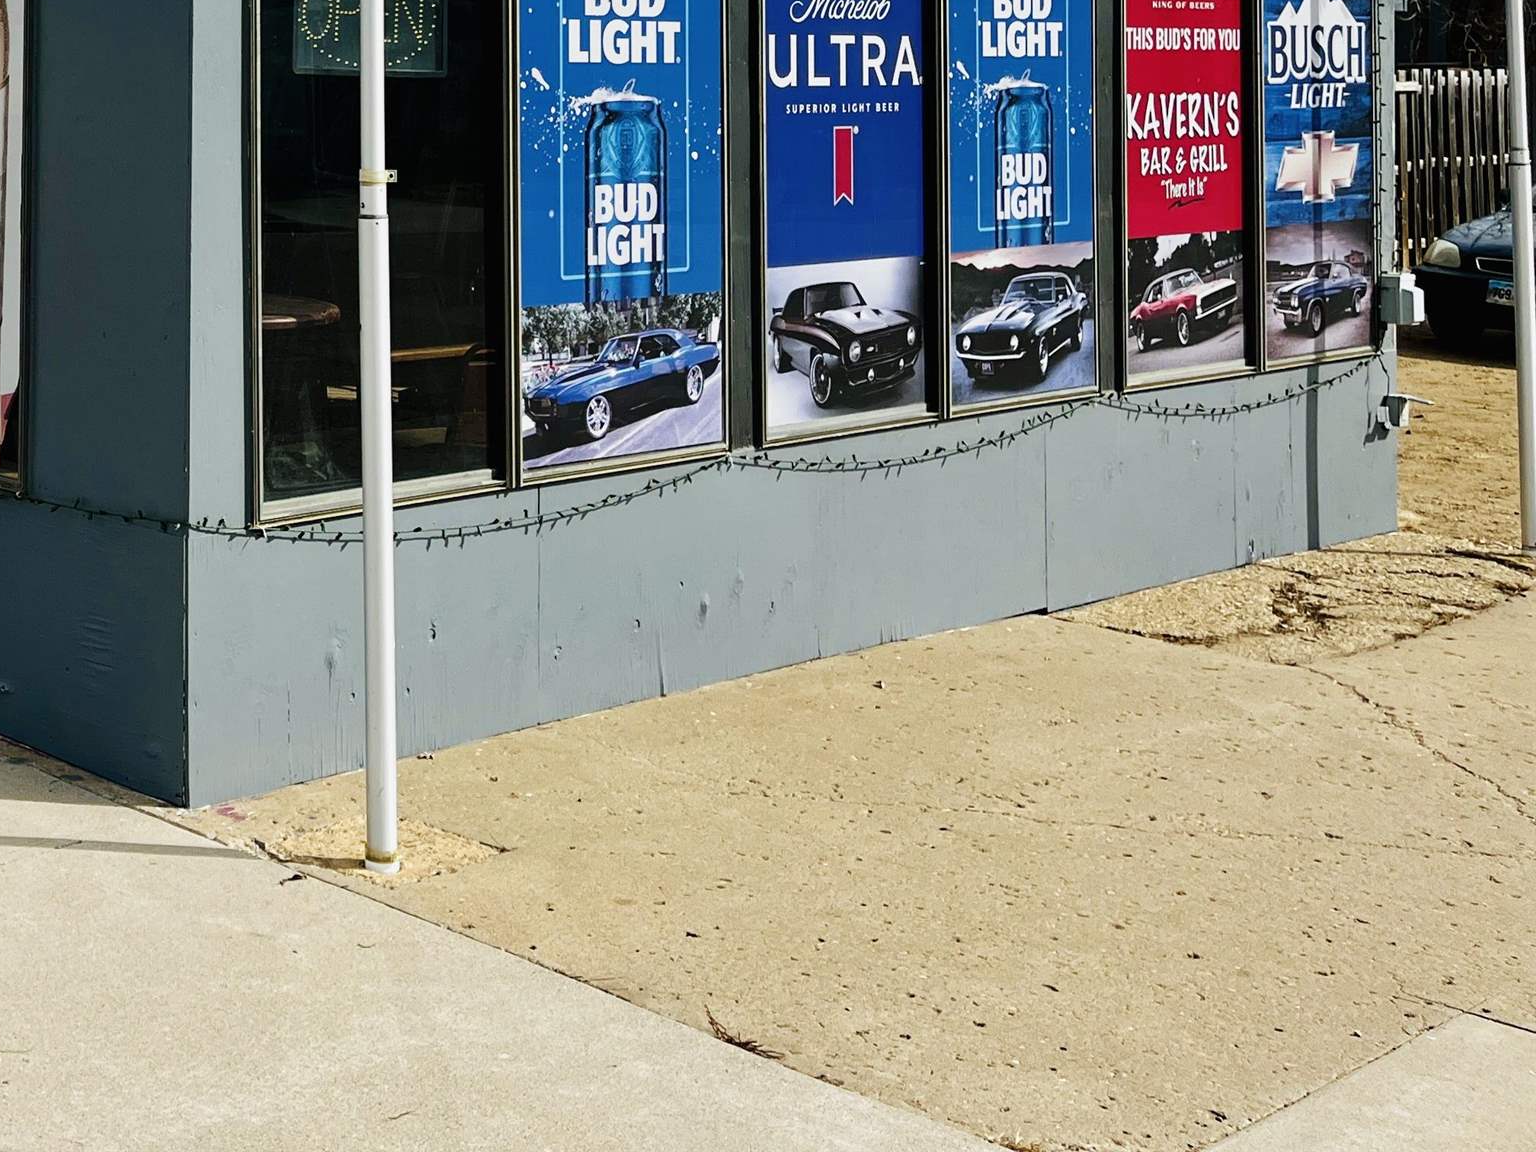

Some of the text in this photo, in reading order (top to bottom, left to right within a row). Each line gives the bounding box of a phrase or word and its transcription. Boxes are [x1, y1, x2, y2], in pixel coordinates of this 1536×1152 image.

[1152, 0, 1215, 10] KING OF BEERS
[568, 19, 681, 64] LIGHT
[982, 22, 1063, 58] LIGHT
[1126, 27, 1241, 51] THIS BUD'S FOR YOU
[1268, 22, 1366, 84] BUSCH
[768, 34, 921, 88] ULTRA
[785, 102, 900, 115] SUPERIOR LIGHT BEER
[1290, 83, 1347, 109] LIGHT
[1126, 91, 1240, 140] KAVERN'S
[1001, 153, 1047, 187] BUD
[1140, 144, 1228, 176] BAR & GRILL
[594, 183, 658, 224] BUD
[996, 186, 1052, 221] LIGHT
[1188, 177, 1197, 197] It
[587, 223, 665, 266] LIGHT
